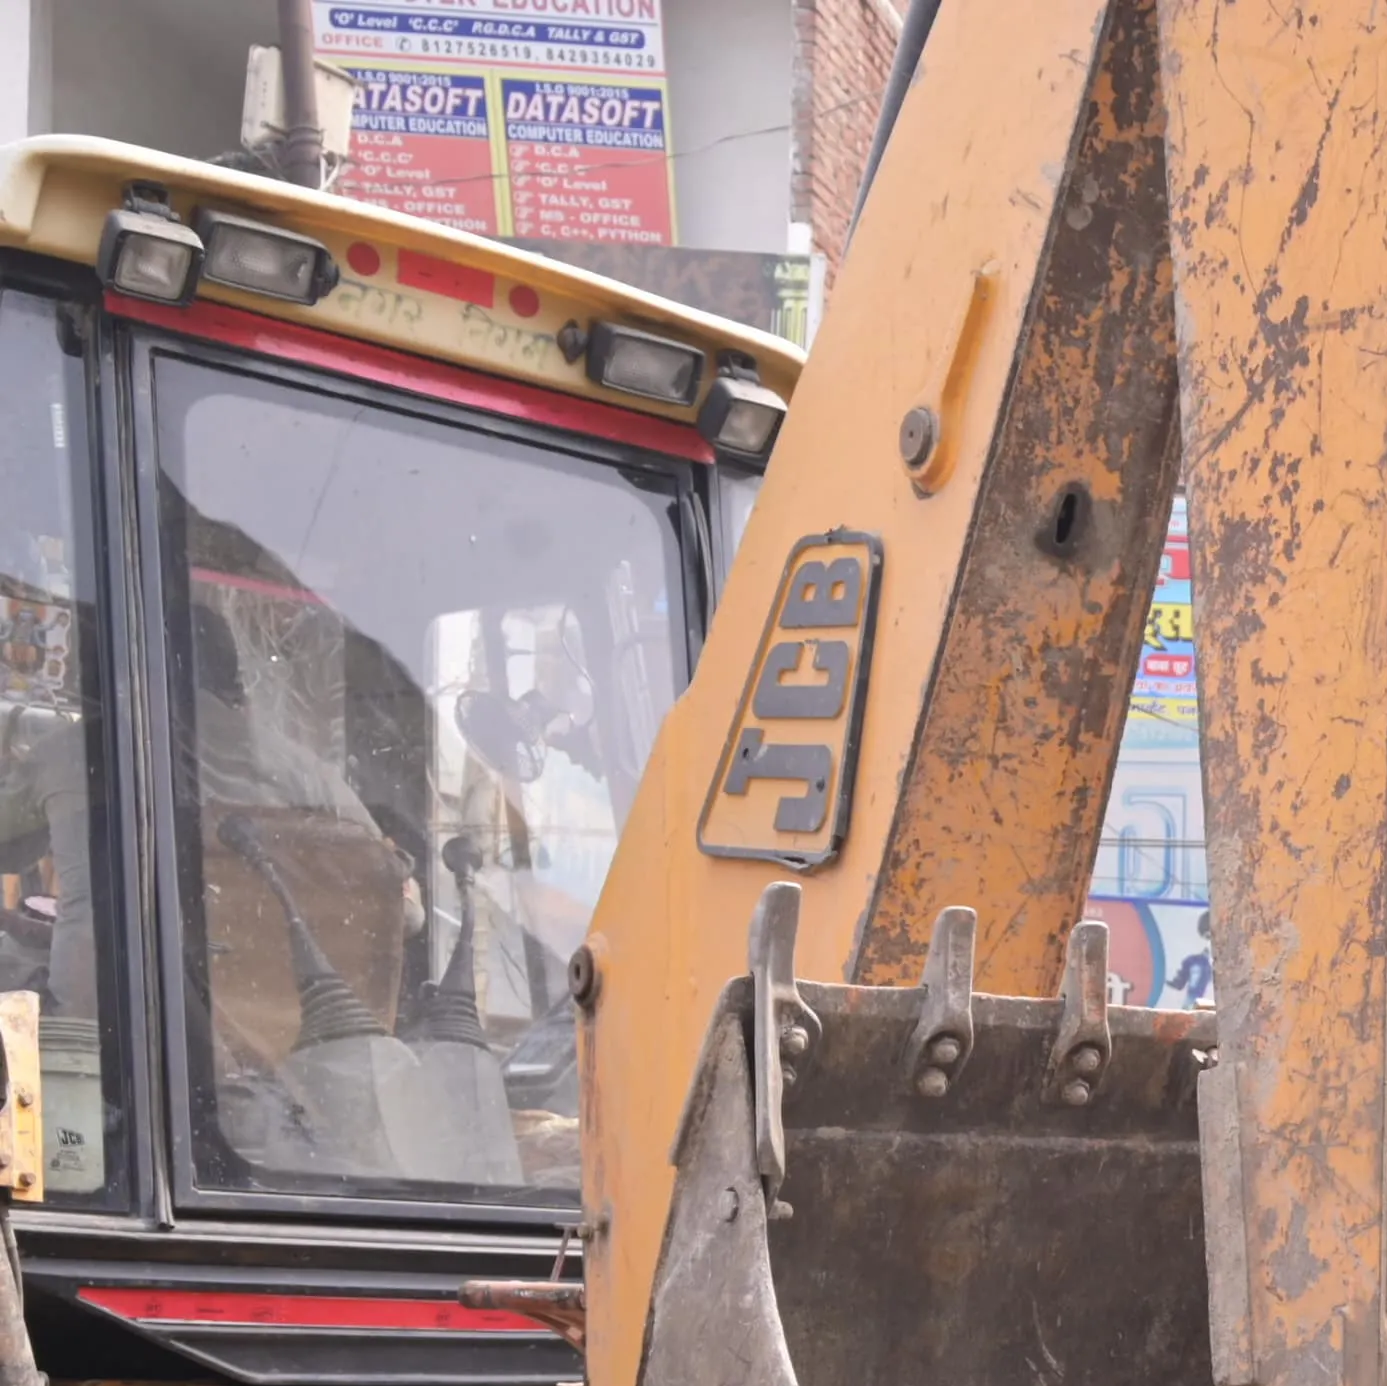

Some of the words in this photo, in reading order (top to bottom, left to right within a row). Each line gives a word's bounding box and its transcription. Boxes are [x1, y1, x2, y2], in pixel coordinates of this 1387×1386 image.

[358, 15, 397, 30] Level
[547, 27, 590, 42] TALLY
[608, 31, 639, 45] GST
[322, 33, 383, 48] OFFICE
[352, 82, 483, 117] ATASOFT
[507, 91, 661, 129] DATASOFT
[351, 114, 406, 132] MPUTER
[409, 117, 487, 136] EDUCATION
[508, 124, 583, 143] COMPUTER
[586, 128, 664, 148] EDUCATION
[386, 168, 431, 180] Level
[421, 186, 457, 199] GST
[562, 179, 608, 192] Level
[403, 200, 466, 215] OFFICE
[598, 197, 633, 211] GST
[580, 212, 641, 228] OFFICE
[597, 227, 662, 243] PYTHON
[723, 557, 862, 833] JCB
